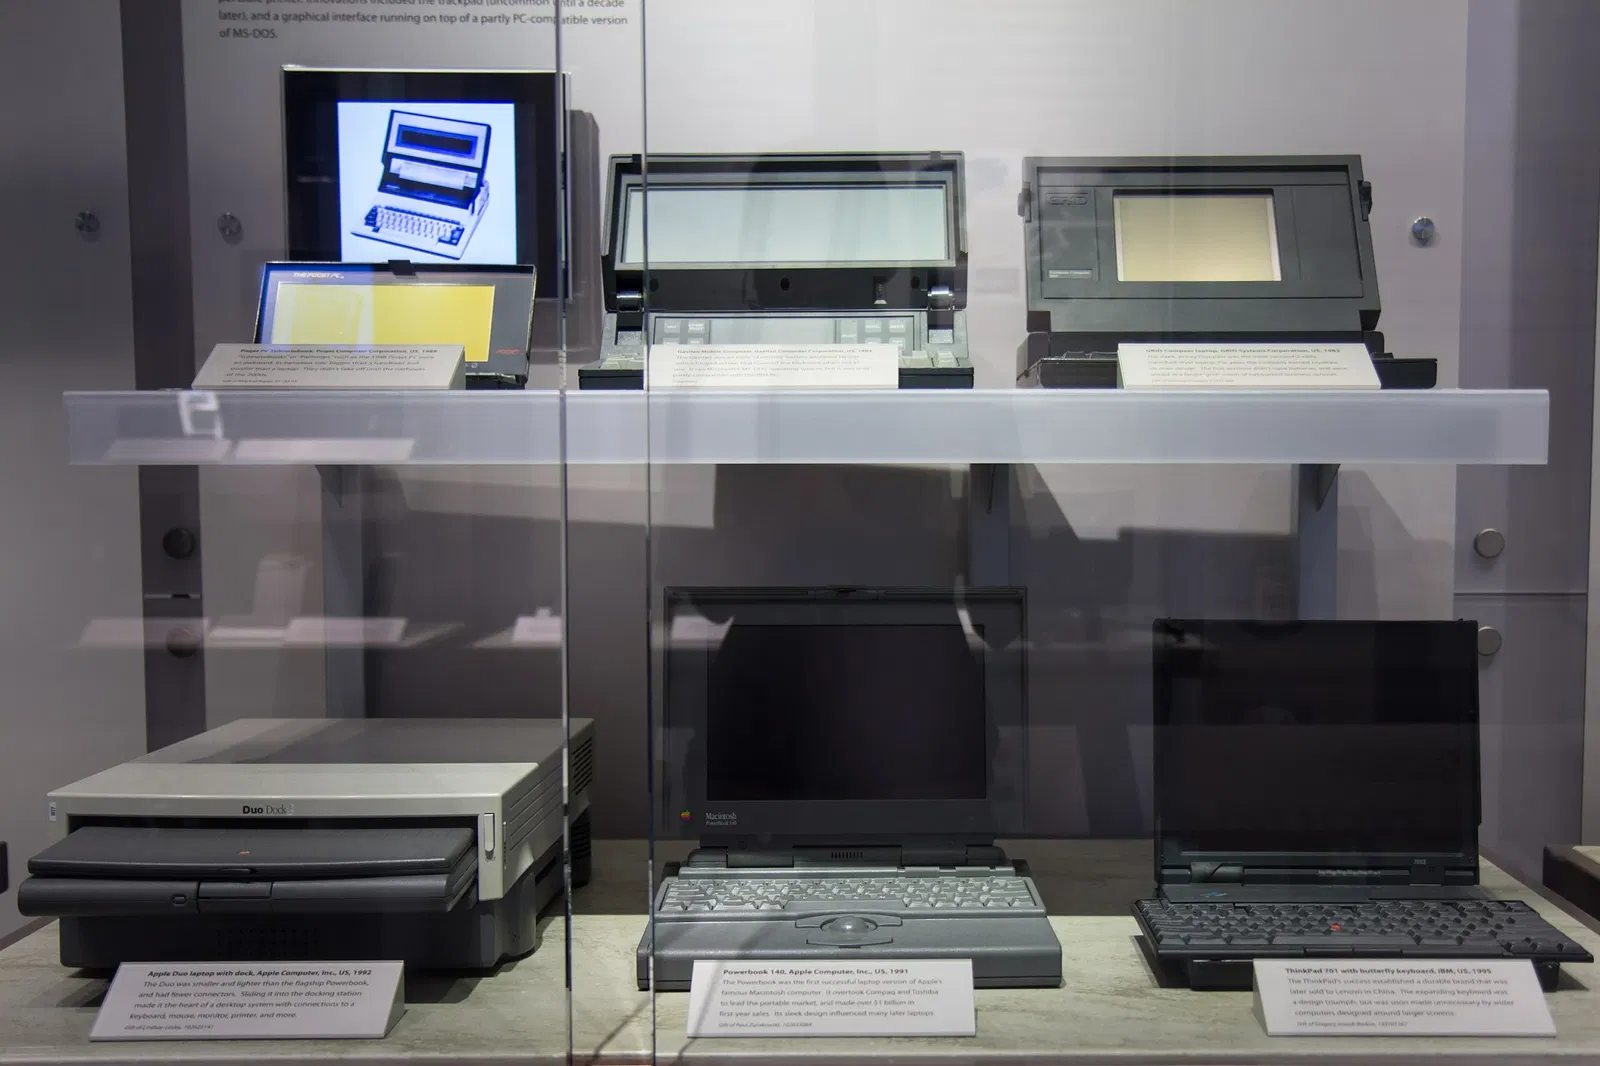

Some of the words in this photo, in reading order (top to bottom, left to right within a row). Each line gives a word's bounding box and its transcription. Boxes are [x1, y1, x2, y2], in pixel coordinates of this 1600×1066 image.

[251, 10, 271, 21] and
[273, 13, 279, 21] a
[281, 11, 329, 24] graphical
[332, 11, 378, 22] interface
[380, 13, 421, 25] running
[423, 15, 437, 23] on
[439, 14, 454, 25] top
[459, 13, 471, 23] of
[471, 15, 478, 23] a
[480, 14, 511, 26] partly
[591, 15, 628, 25] version
[219, 27, 231, 38] of
[242, 805, 264, 815] Duo
[266, 804, 287, 815] Dock
[705, 811, 737, 820] Macintosh
[148, 970, 171, 978] Apple
[189, 970, 215, 978] laptop
[257, 970, 279, 978] Apple
[281, 969, 320, 978] Computer,
[339, 969, 350, 977] US,
[236, 980, 261, 988] lighter
[295, 980, 325, 988] flagship
[240, 991, 266, 999] Sliding
[304, 990, 335, 999] docking
[215, 1001, 246, 1010] desktop
[248, 1001, 274, 1009] system
